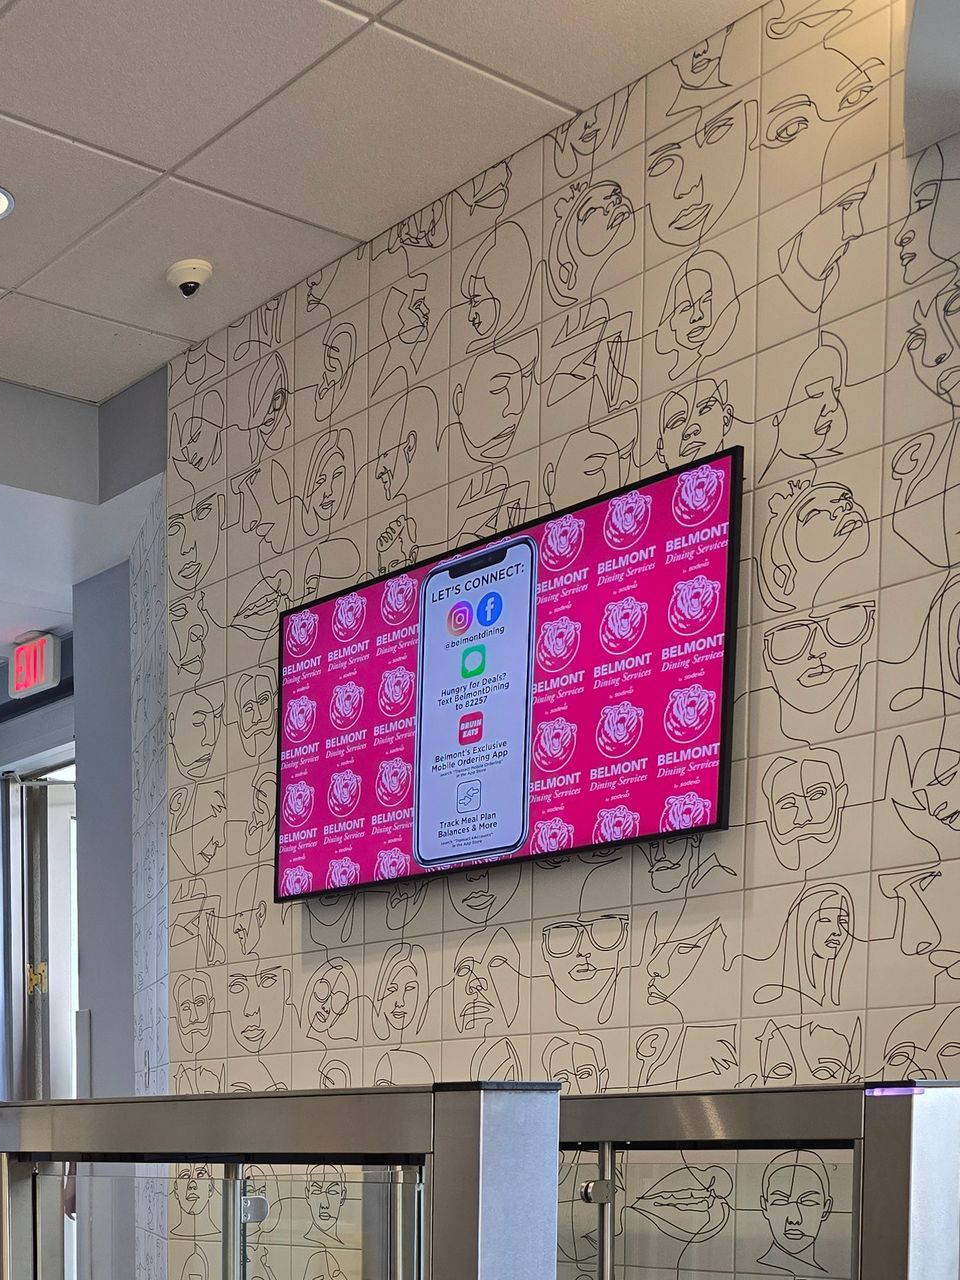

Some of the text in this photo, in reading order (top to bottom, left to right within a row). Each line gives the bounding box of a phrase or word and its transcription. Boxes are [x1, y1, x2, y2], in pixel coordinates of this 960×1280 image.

[665, 521, 729, 552] BELMONT
[597, 545, 656, 575] BELMONT
[665, 539, 728, 565] Dining Services
[431, 563, 525, 603] LET'S CONNECT:
[597, 562, 656, 586] Dining Services
[560, 584, 588, 597] Services
[445, 626, 505, 649] @belmontdining
[661, 632, 725, 660] BELMONT
[328, 640, 369, 662] BELMONT
[376, 645, 397, 656] Dining
[15, 638, 48, 692] EXIT
[283, 656, 321, 676] BELMONT
[328, 661, 347, 671] Dining
[593, 652, 652, 678] BELMONT
[661, 650, 724, 672] Dining Services
[441, 672, 507, 697] Hungry for Deals?
[593, 669, 651, 689] Dining Services
[437, 681, 510, 707] Text BelmontDining
[556, 687, 584, 698] Services
[455, 695, 488, 711] to 82257
[326, 729, 367, 749] BELMONT
[373, 736, 394, 746] Dining
[462, 728, 479, 738] EATS
[281, 742, 319, 760] BELMONT
[326, 748, 345, 759] Dining
[431, 749, 509, 773] Mobile Ordering App
[435, 740, 507, 763] Belmont's Exclusive
[657, 742, 720, 766] BELMONT
[590, 758, 648, 780] BELMONT
[656, 759, 720, 778] Dining Services
[589, 774, 648, 791] Dining Services
[553, 788, 581, 798] Services
[323, 818, 365, 835] BELMONT
[371, 825, 392, 835] Dining
[437, 821, 498, 839] Balances & More
[439, 812, 497, 829] Track Meal Plan
[279, 828, 317, 844] BELMONT
[323, 834, 343, 845] Dining
